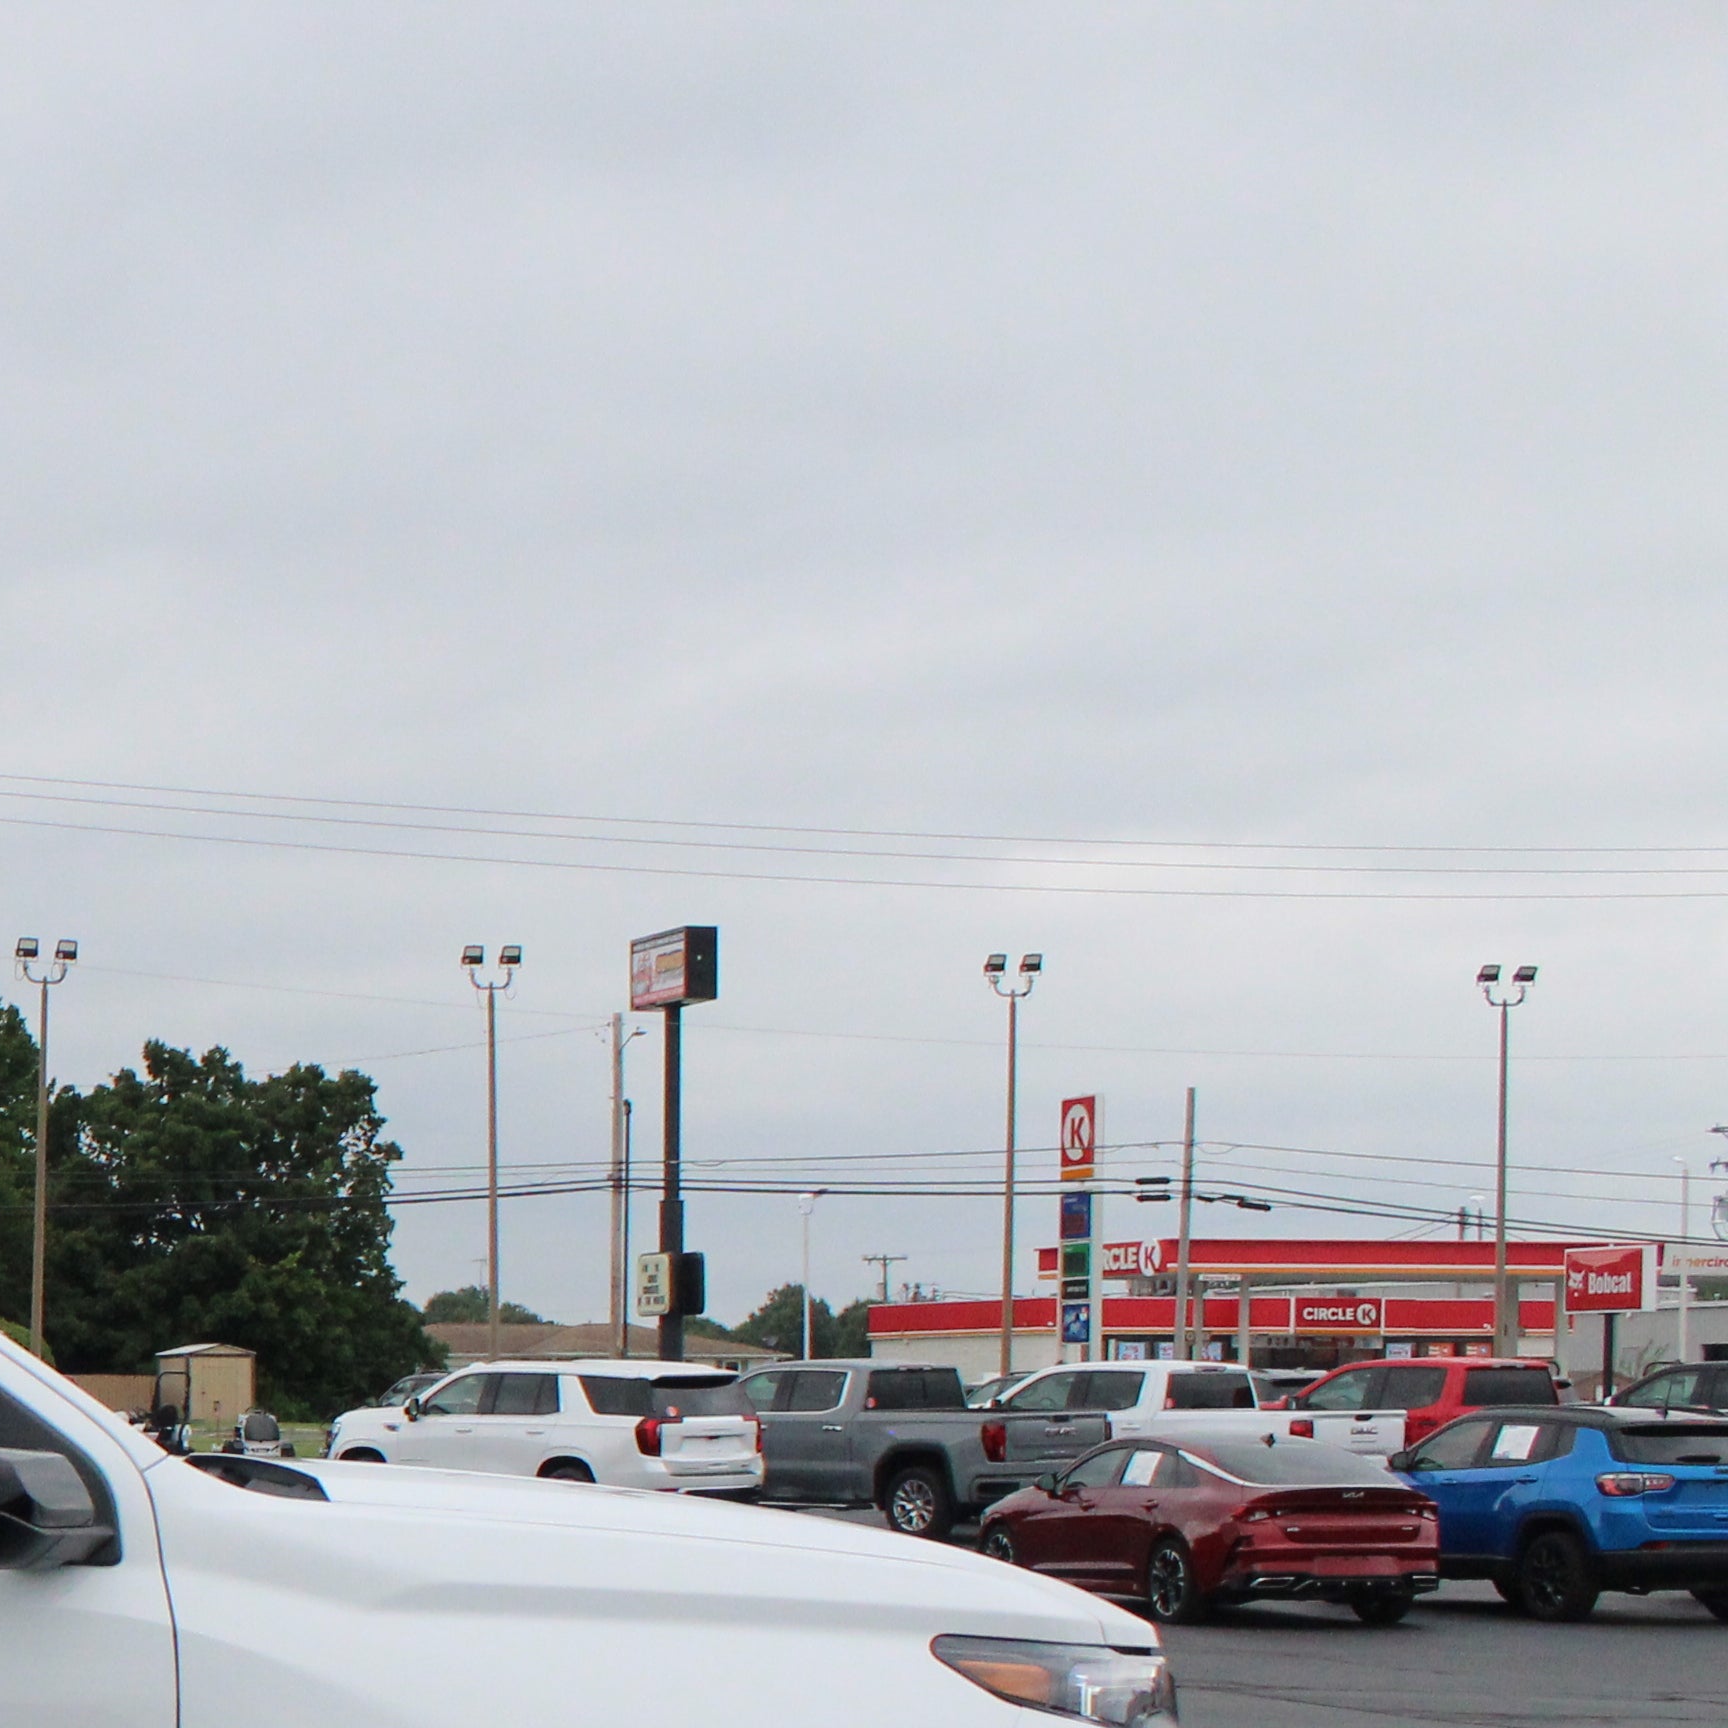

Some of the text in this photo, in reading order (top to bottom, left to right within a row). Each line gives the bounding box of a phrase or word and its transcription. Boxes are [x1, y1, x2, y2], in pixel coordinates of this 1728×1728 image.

[1069, 1116, 1085, 1149] K
[1103, 1247, 1138, 1271] RCLE
[1588, 1271, 1632, 1295] Bobcat
[1302, 1307, 1355, 1321] CIRCLE
